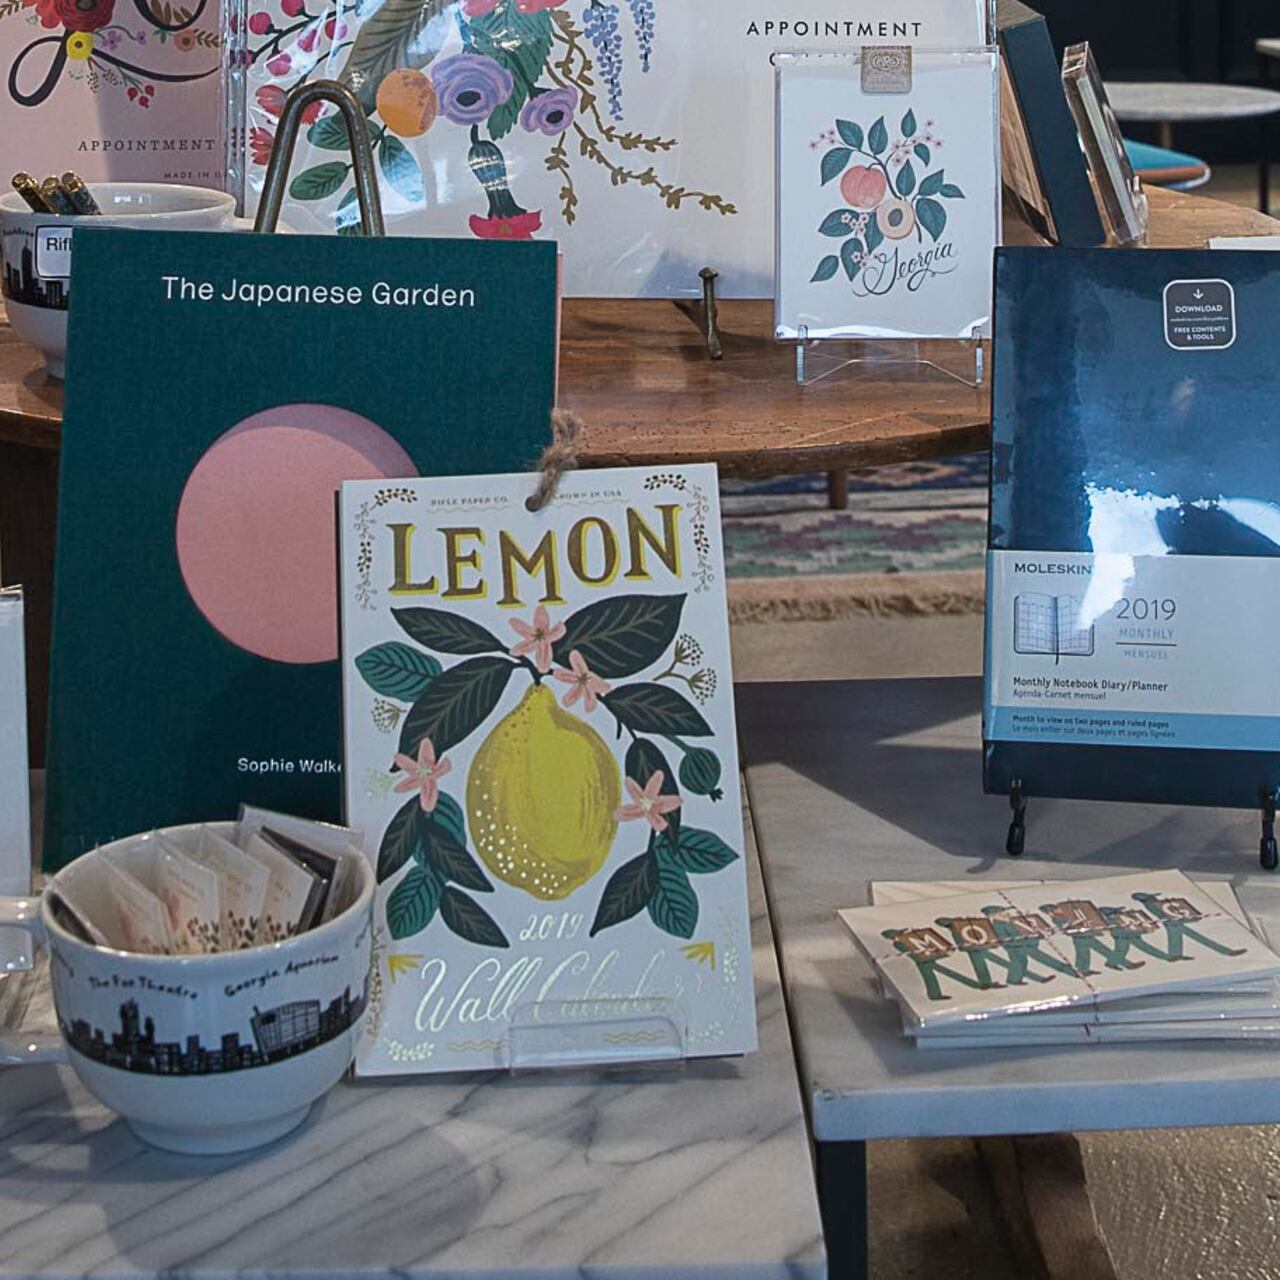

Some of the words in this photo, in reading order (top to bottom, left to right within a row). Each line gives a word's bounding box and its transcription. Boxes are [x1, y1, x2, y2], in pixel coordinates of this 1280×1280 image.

[746, 21, 923, 37] APPOINTMENT
[78, 139, 216, 152] APPOINTMENT
[163, 170, 193, 180] MADE
[197, 170, 210, 180] IN
[45, 236, 72, 251] Rifl
[851, 242, 960, 298] Georgia
[161, 275, 215, 300] The
[221, 278, 363, 307] Japanese
[371, 281, 476, 307] Garden
[1174, 304, 1224, 313] DOWNLOAD
[1191, 325, 1227, 333] CONTENTS
[430, 498, 459, 507] RIFLE
[461, 496, 492, 506] PAPER
[554, 491, 588, 503] ROWN
[385, 503, 684, 609] LEMON
[1013, 562, 1093, 575] MOLESKIN
[1116, 597, 1177, 622] 2019
[1119, 627, 1175, 640] MONTHLY
[1123, 649, 1170, 660] MENSUEL
[1013, 676, 1050, 689] Monthly
[1053, 677, 1099, 690] Notebook
[1101, 679, 1169, 692] Diary/Planner
[1012, 688, 1072, 700] Agenda-Carnet
[1073, 691, 1107, 701] mensuel
[1012, 714, 1035, 723] Month
[1036, 715, 1045, 723] to
[1046, 716, 1063, 724] view
[1074, 717, 1088, 725] two
[1089, 718, 1111, 728] pages
[1112, 719, 1125, 727] and
[1127, 719, 1146, 728] ruled
[1148, 720, 1169, 729] pages
[1095, 727, 1115, 737] pages
[1127, 729, 1148, 738] pages
[237, 757, 295, 774] Sophie
[299, 758, 342, 773] Walk
[519, 912, 585, 941] 2019
[224, 969, 279, 997] Georgia
[285, 955, 339, 977] Aquarium
[88, 976, 109, 989] The
[112, 973, 134, 987] Fox
[138, 975, 199, 1000] Theatre
[414, 956, 543, 1033] Wall
